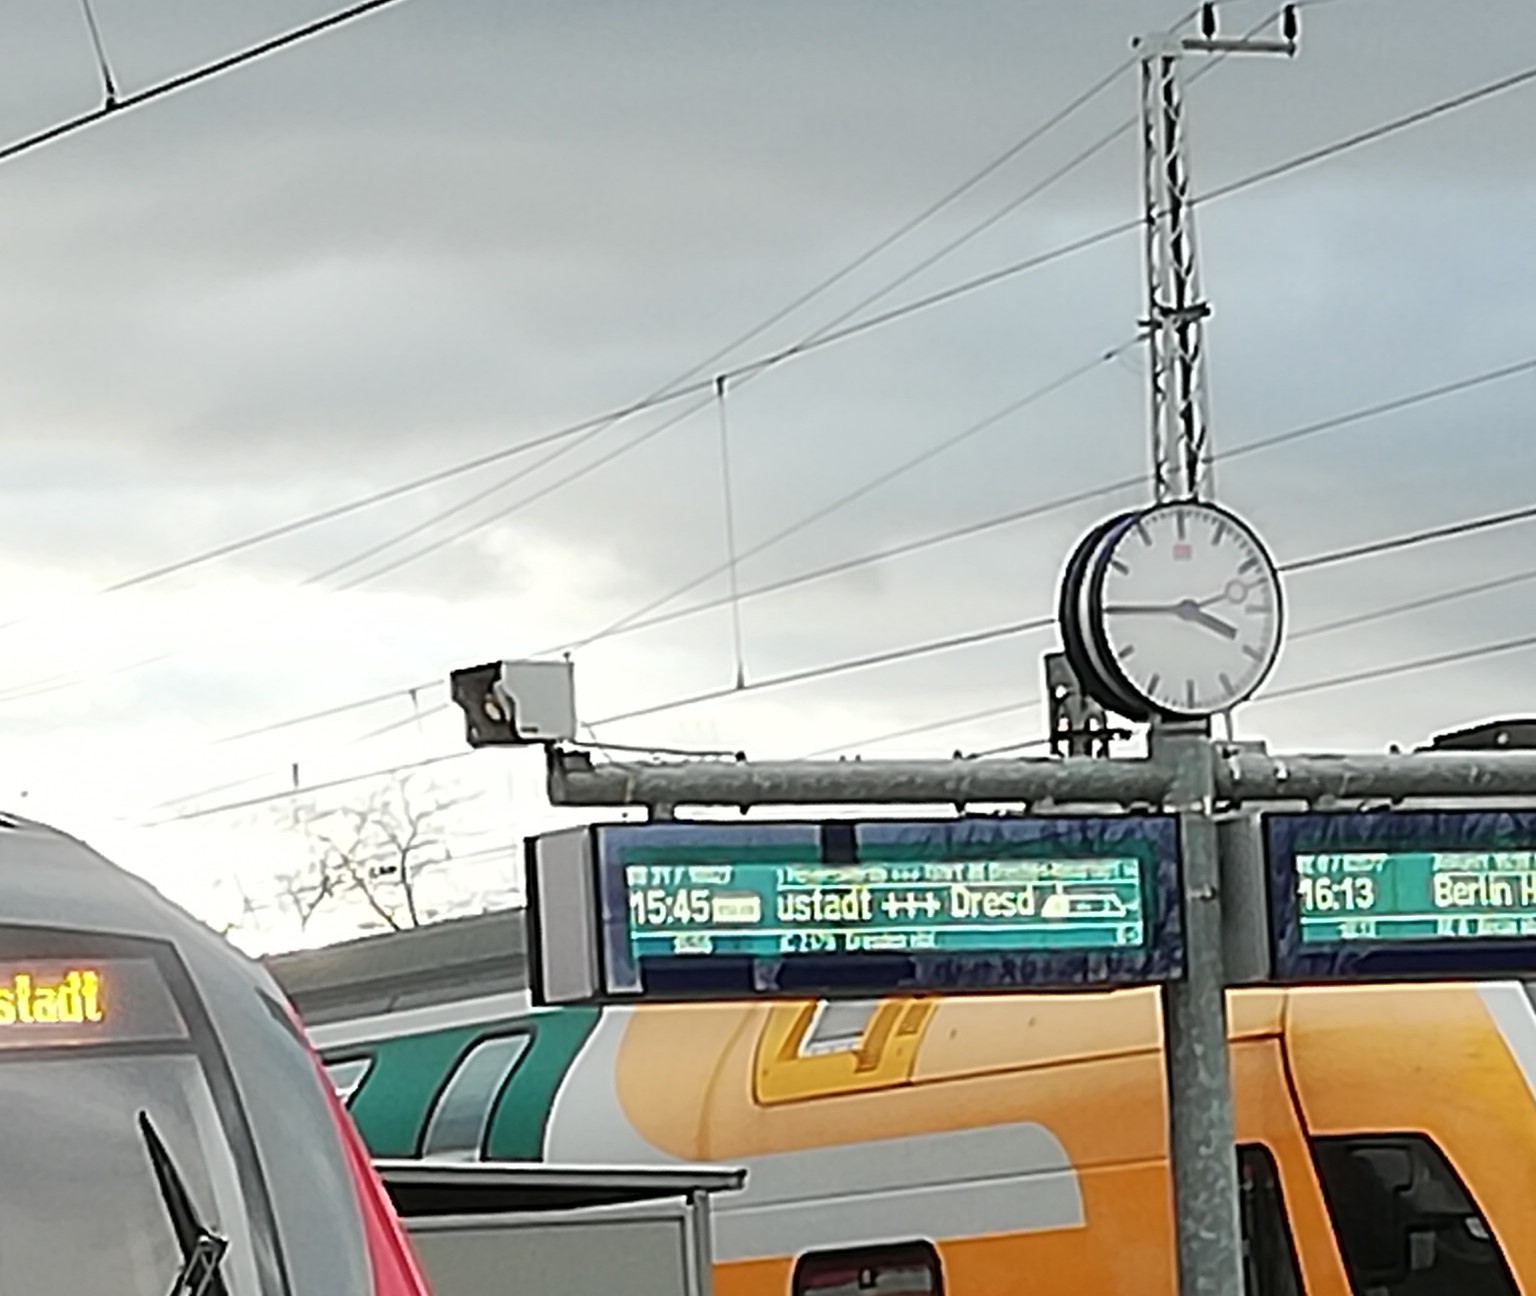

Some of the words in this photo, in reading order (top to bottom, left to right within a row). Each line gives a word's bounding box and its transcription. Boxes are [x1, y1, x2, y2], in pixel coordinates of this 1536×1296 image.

[629, 889, 711, 925] 15:45
[777, 888, 873, 923] ustadt
[950, 881, 1036, 919] Dresd
[1297, 876, 1375, 911] 16:13
[1433, 872, 1513, 908] Berlin
